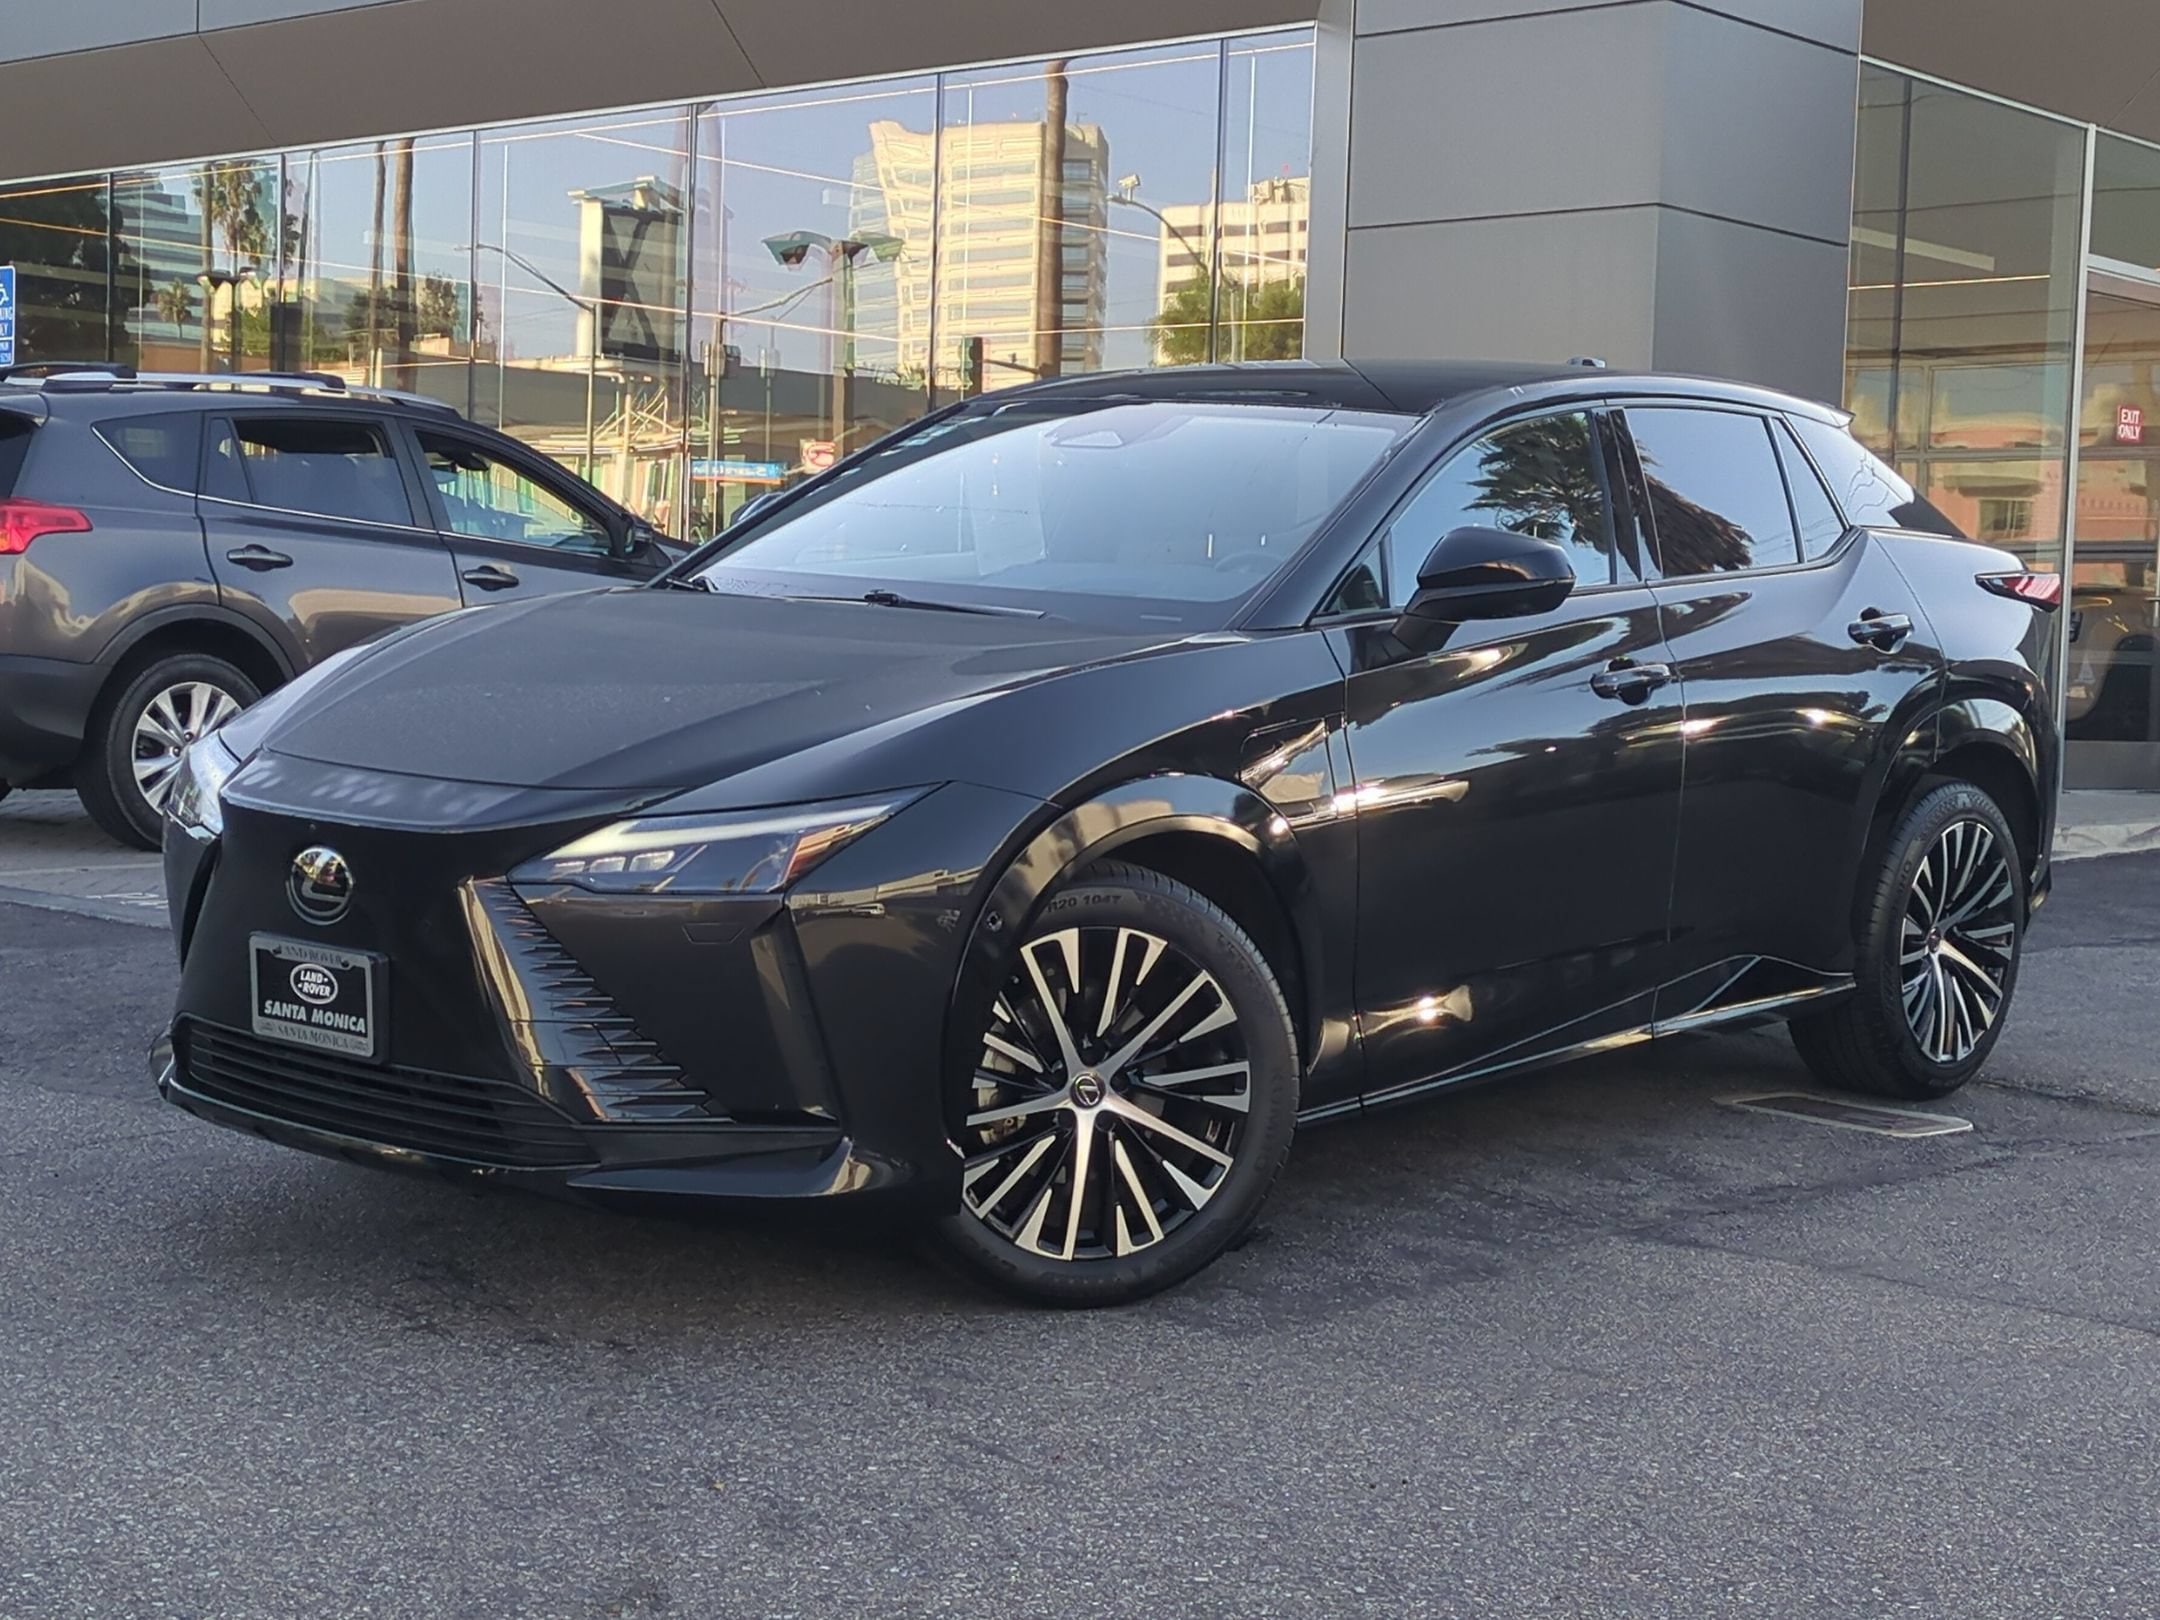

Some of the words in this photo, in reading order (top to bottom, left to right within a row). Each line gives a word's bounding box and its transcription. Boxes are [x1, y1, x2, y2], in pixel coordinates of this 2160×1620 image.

[2121, 408, 2140, 424] EXIT
[2119, 424, 2141, 440] ONLY
[300, 969, 323, 984] LAND
[302, 981, 331, 997] ROVER
[264, 1000, 307, 1022] SANTA
[311, 1008, 366, 1034] MONICA
[277, 1024, 309, 1041] SANTA
[309, 1029, 349, 1049] MONICA
